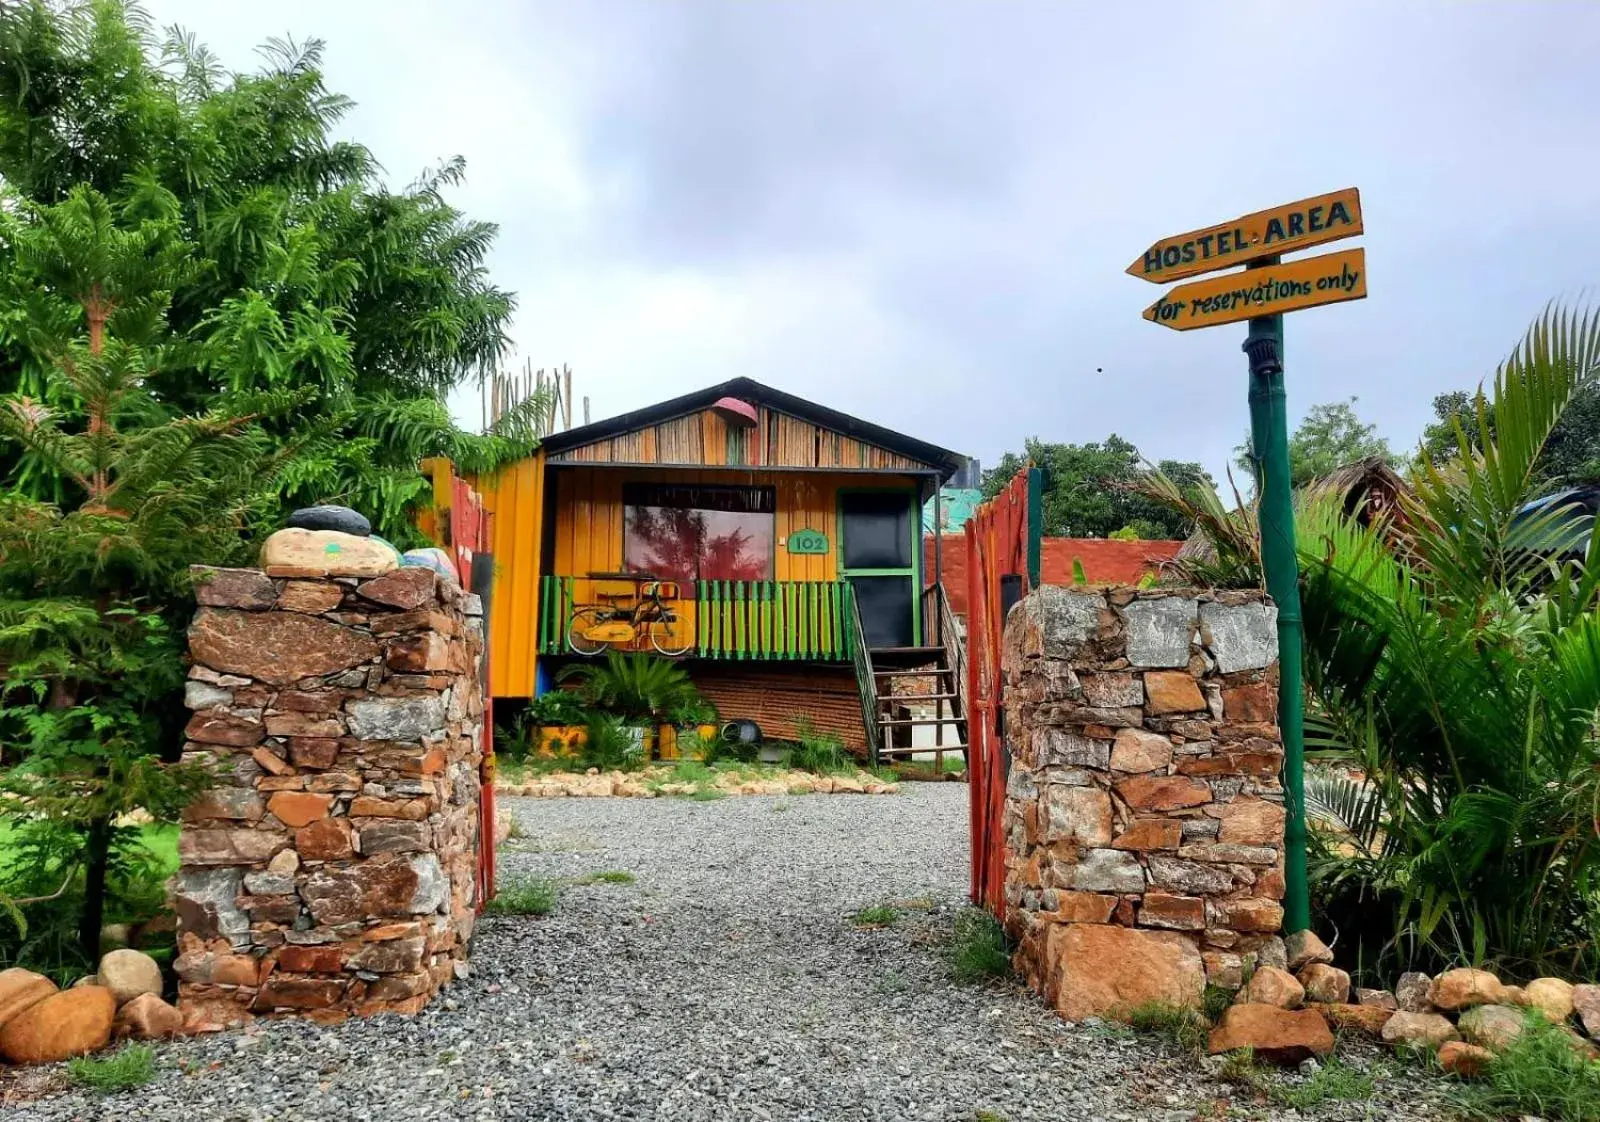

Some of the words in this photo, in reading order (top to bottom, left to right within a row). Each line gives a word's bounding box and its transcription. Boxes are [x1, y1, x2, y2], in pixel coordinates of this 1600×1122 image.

[1143, 228, 1250, 273] HOSTEL
[1263, 200, 1352, 244] AREA
[1150, 296, 1186, 321] for
[1191, 277, 1312, 316] reservations
[1316, 263, 1359, 292] only
[796, 536, 824, 551] 102
